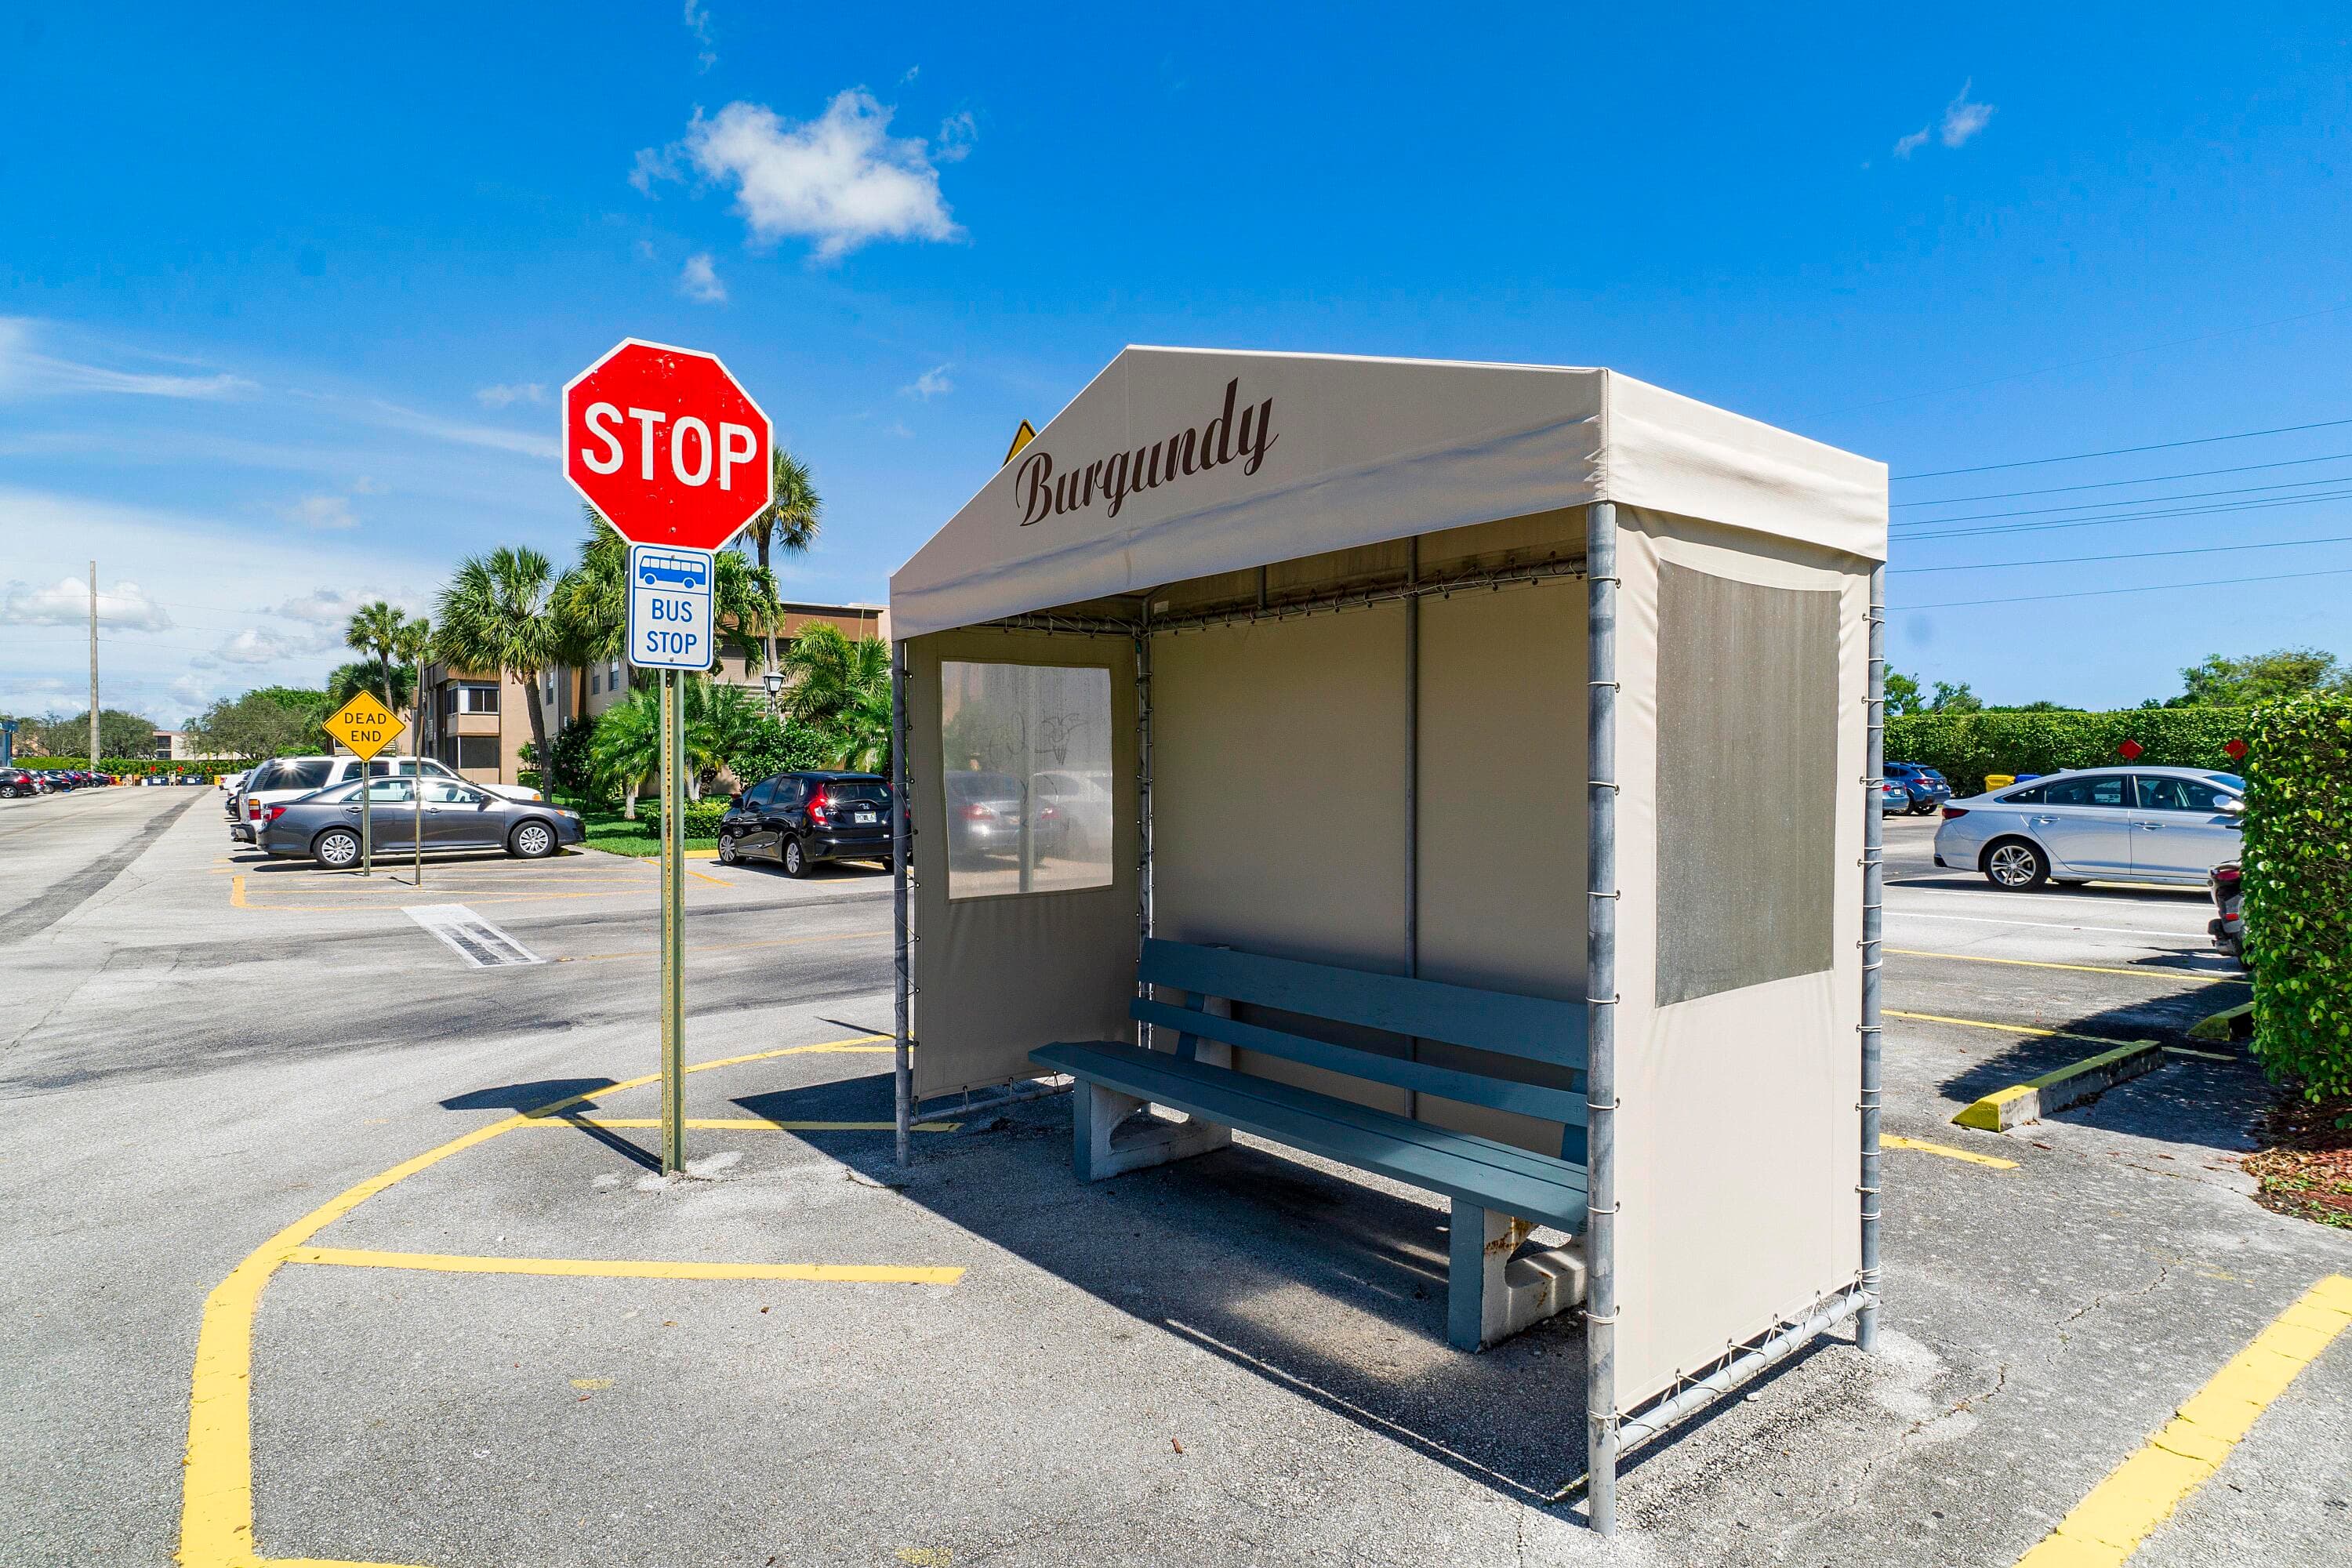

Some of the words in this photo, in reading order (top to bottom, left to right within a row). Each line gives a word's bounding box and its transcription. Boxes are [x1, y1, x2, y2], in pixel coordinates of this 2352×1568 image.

[581, 401, 757, 491] STOP
[1016, 376, 1279, 526] Burgundy
[652, 598, 693, 622] BUS
[646, 630, 698, 655] STOP
[344, 712, 387, 724] DEAD
[350, 730, 382, 742] END
